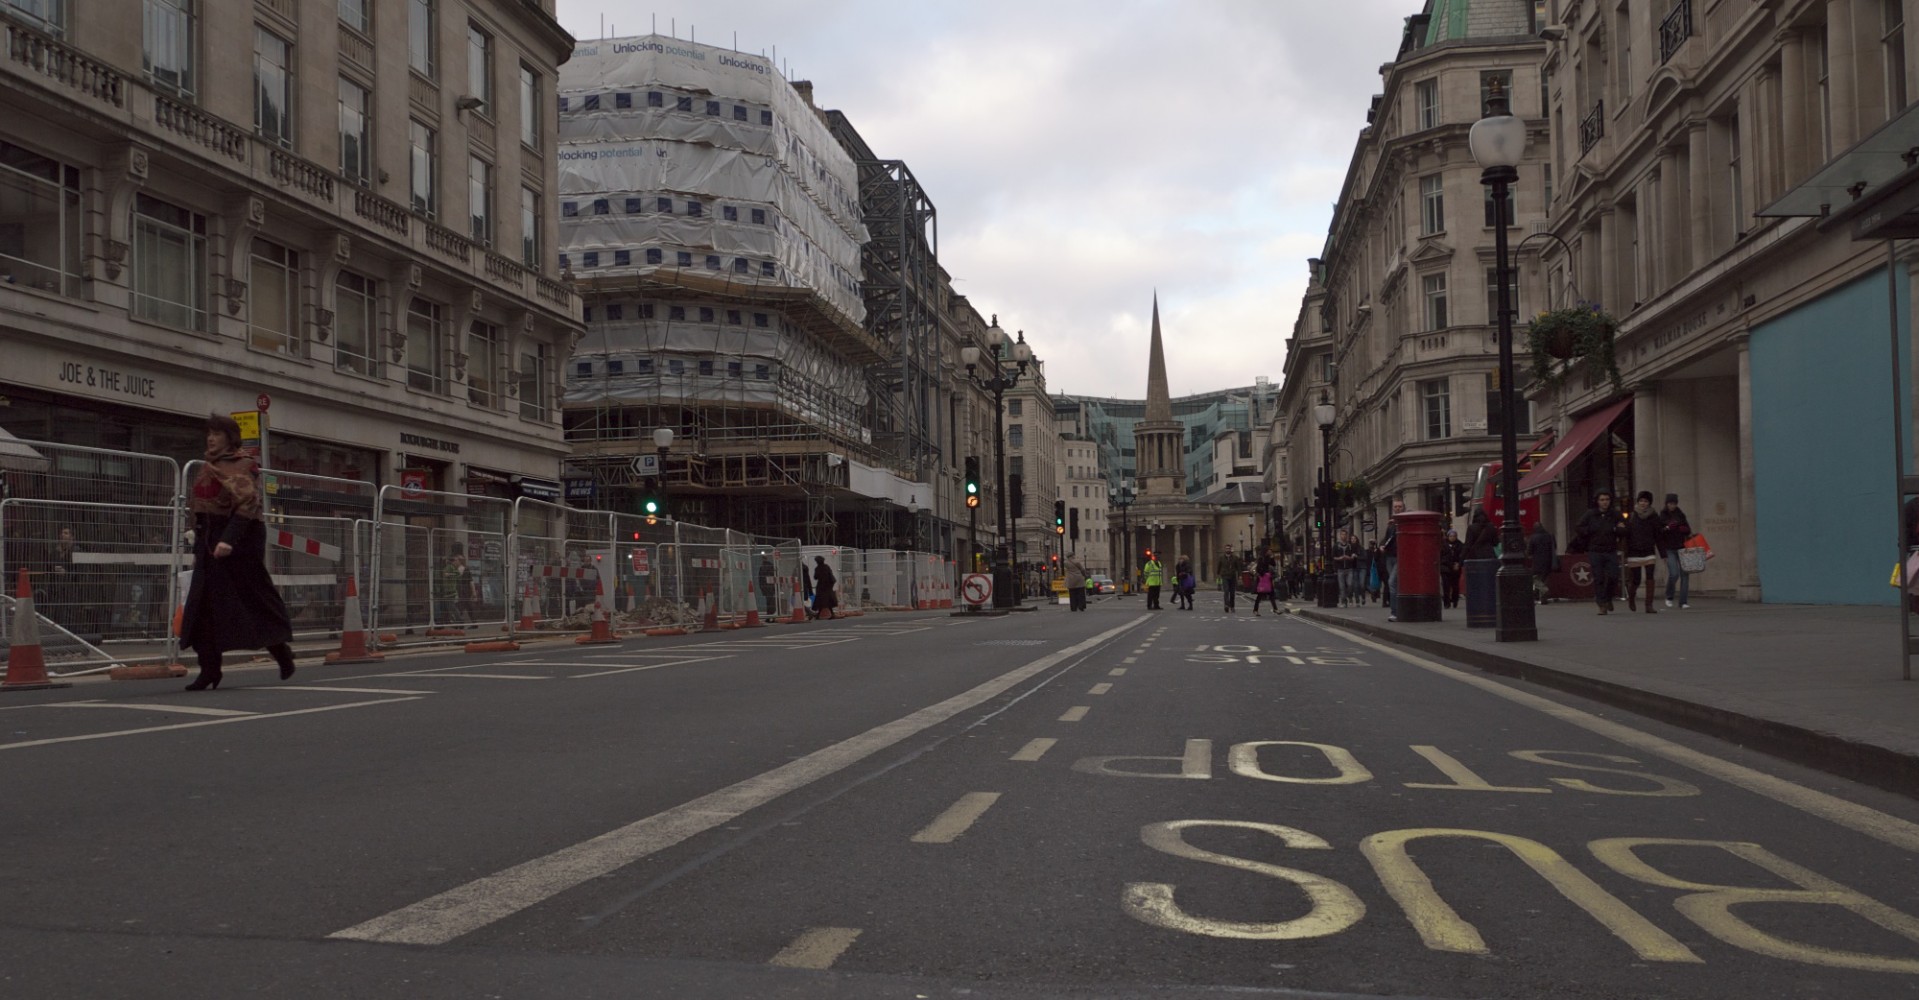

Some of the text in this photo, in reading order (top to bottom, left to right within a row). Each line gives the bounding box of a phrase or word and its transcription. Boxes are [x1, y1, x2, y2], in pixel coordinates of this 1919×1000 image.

[571, 46, 598, 58] ential
[613, 41, 706, 61] Unlocking potential
[718, 54, 764, 74] Unlocking
[557, 147, 643, 161] nlocking potential
[1683, 311, 1707, 335] HOUSE
[59, 361, 155, 398] JOE & THE JUICE
[570, 487, 592, 496] NEWS
[1184, 654, 1373, 667] BUS
[1071, 738, 1702, 797] STOP
[1122, 819, 1919, 973] BUS
